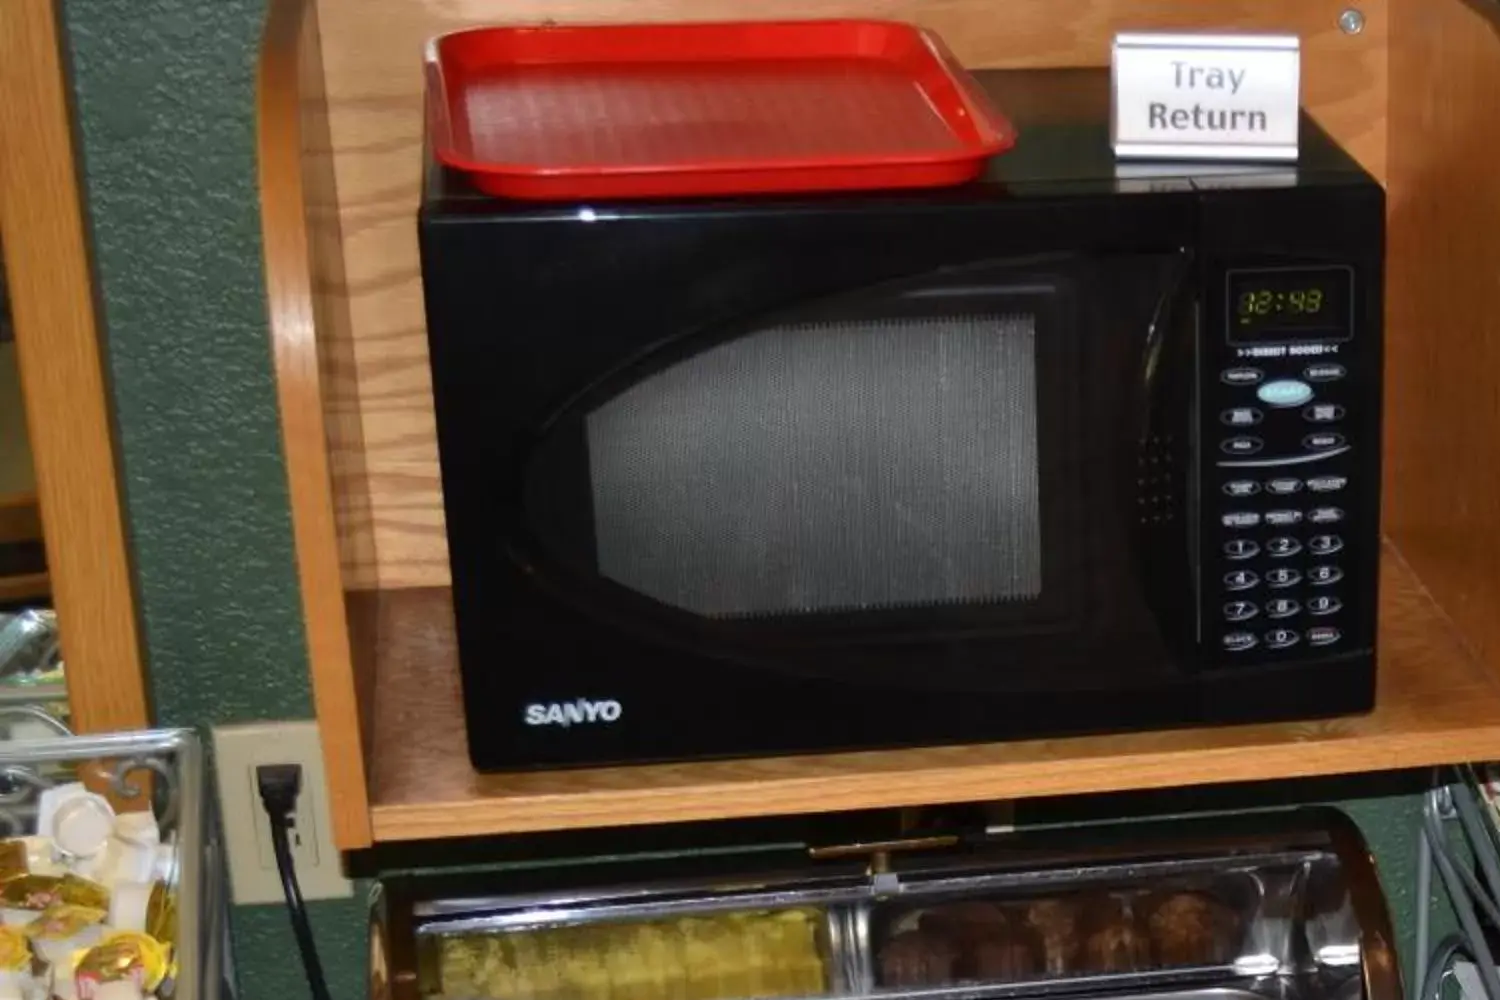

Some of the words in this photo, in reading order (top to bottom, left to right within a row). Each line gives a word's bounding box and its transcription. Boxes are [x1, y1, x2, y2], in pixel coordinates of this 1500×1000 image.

[1171, 61, 1246, 94] Tray
[1149, 102, 1267, 131] Return
[525, 698, 622, 727] SANYO
